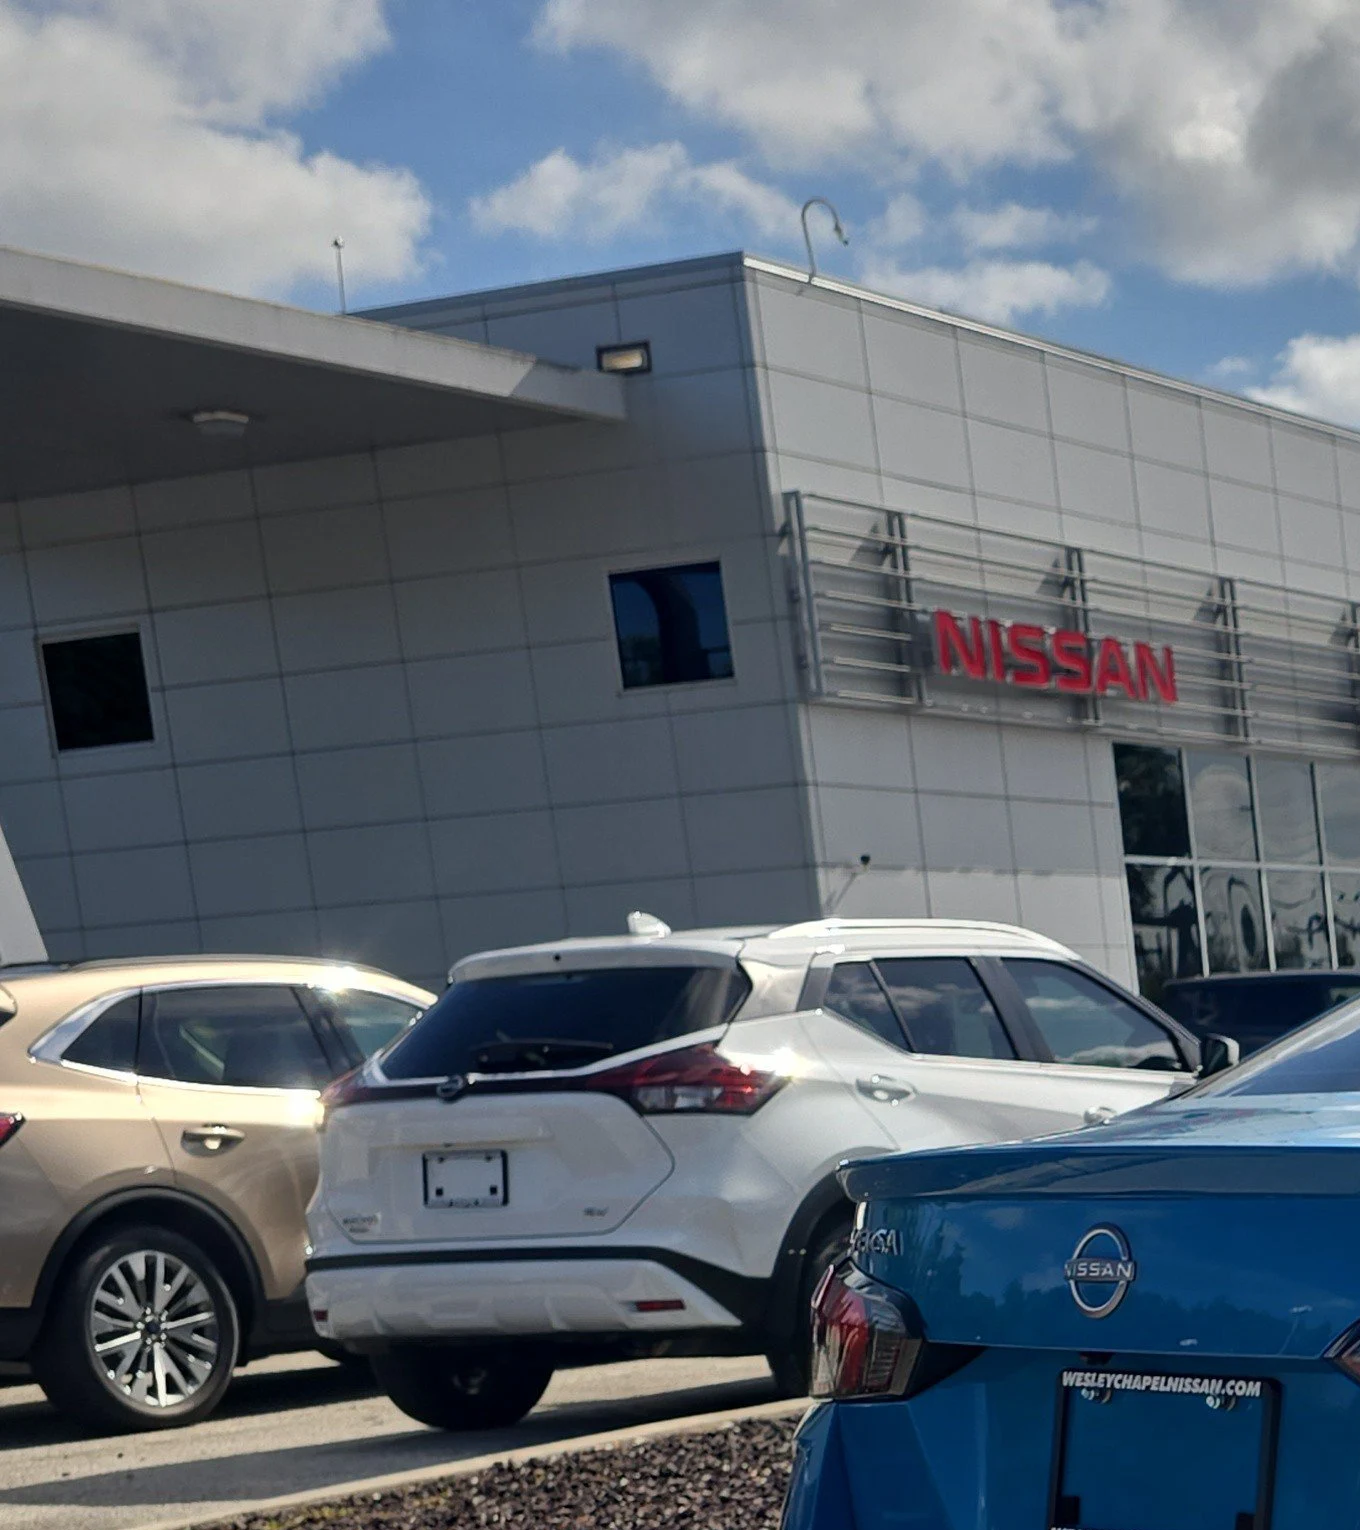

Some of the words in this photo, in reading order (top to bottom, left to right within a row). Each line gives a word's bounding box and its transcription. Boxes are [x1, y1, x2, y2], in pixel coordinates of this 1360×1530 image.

[936, 609, 1178, 705] NISSAN
[1065, 1261, 1133, 1279] NISSAN
[1062, 1371, 1262, 1397] WESLEYCHAPELNISSAN.COM
